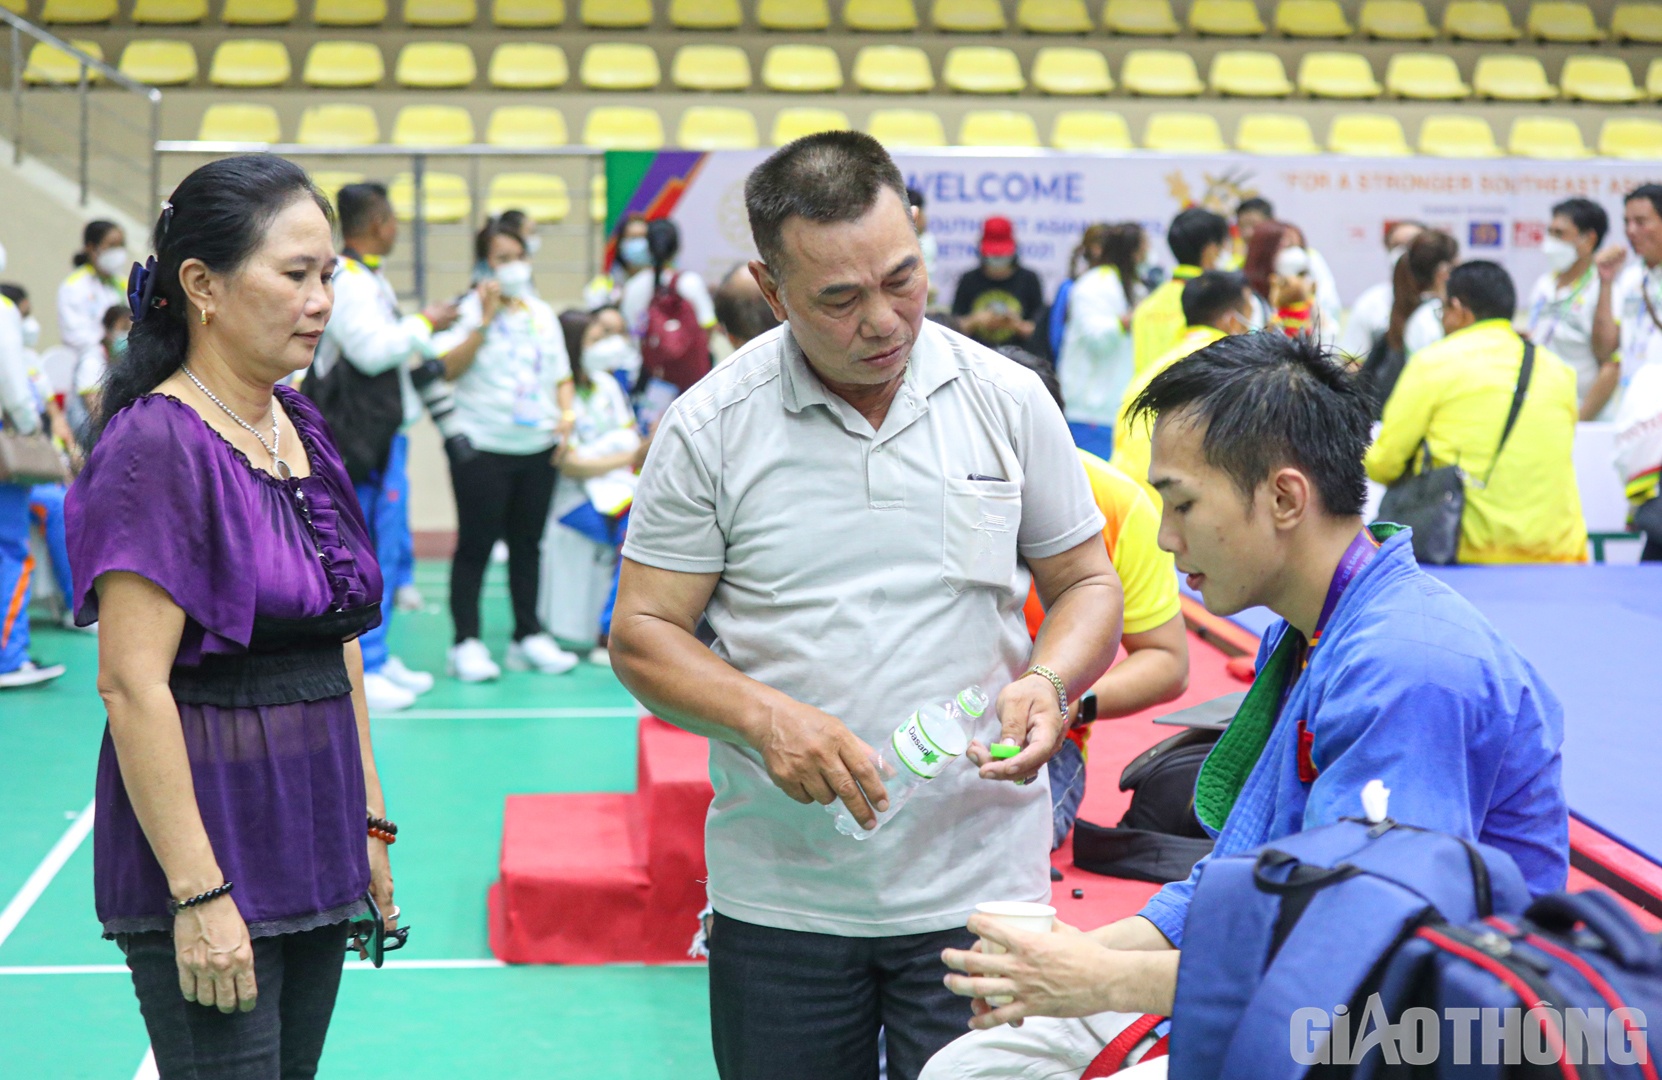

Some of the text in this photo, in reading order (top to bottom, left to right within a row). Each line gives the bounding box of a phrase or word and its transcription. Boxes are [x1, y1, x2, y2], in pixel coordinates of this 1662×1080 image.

[1338, 172, 1351, 191] A
[1357, 172, 1473, 193] STRONGER
[1479, 174, 1602, 194] SOUTHEAST
[908, 725, 933, 757] Dasani
